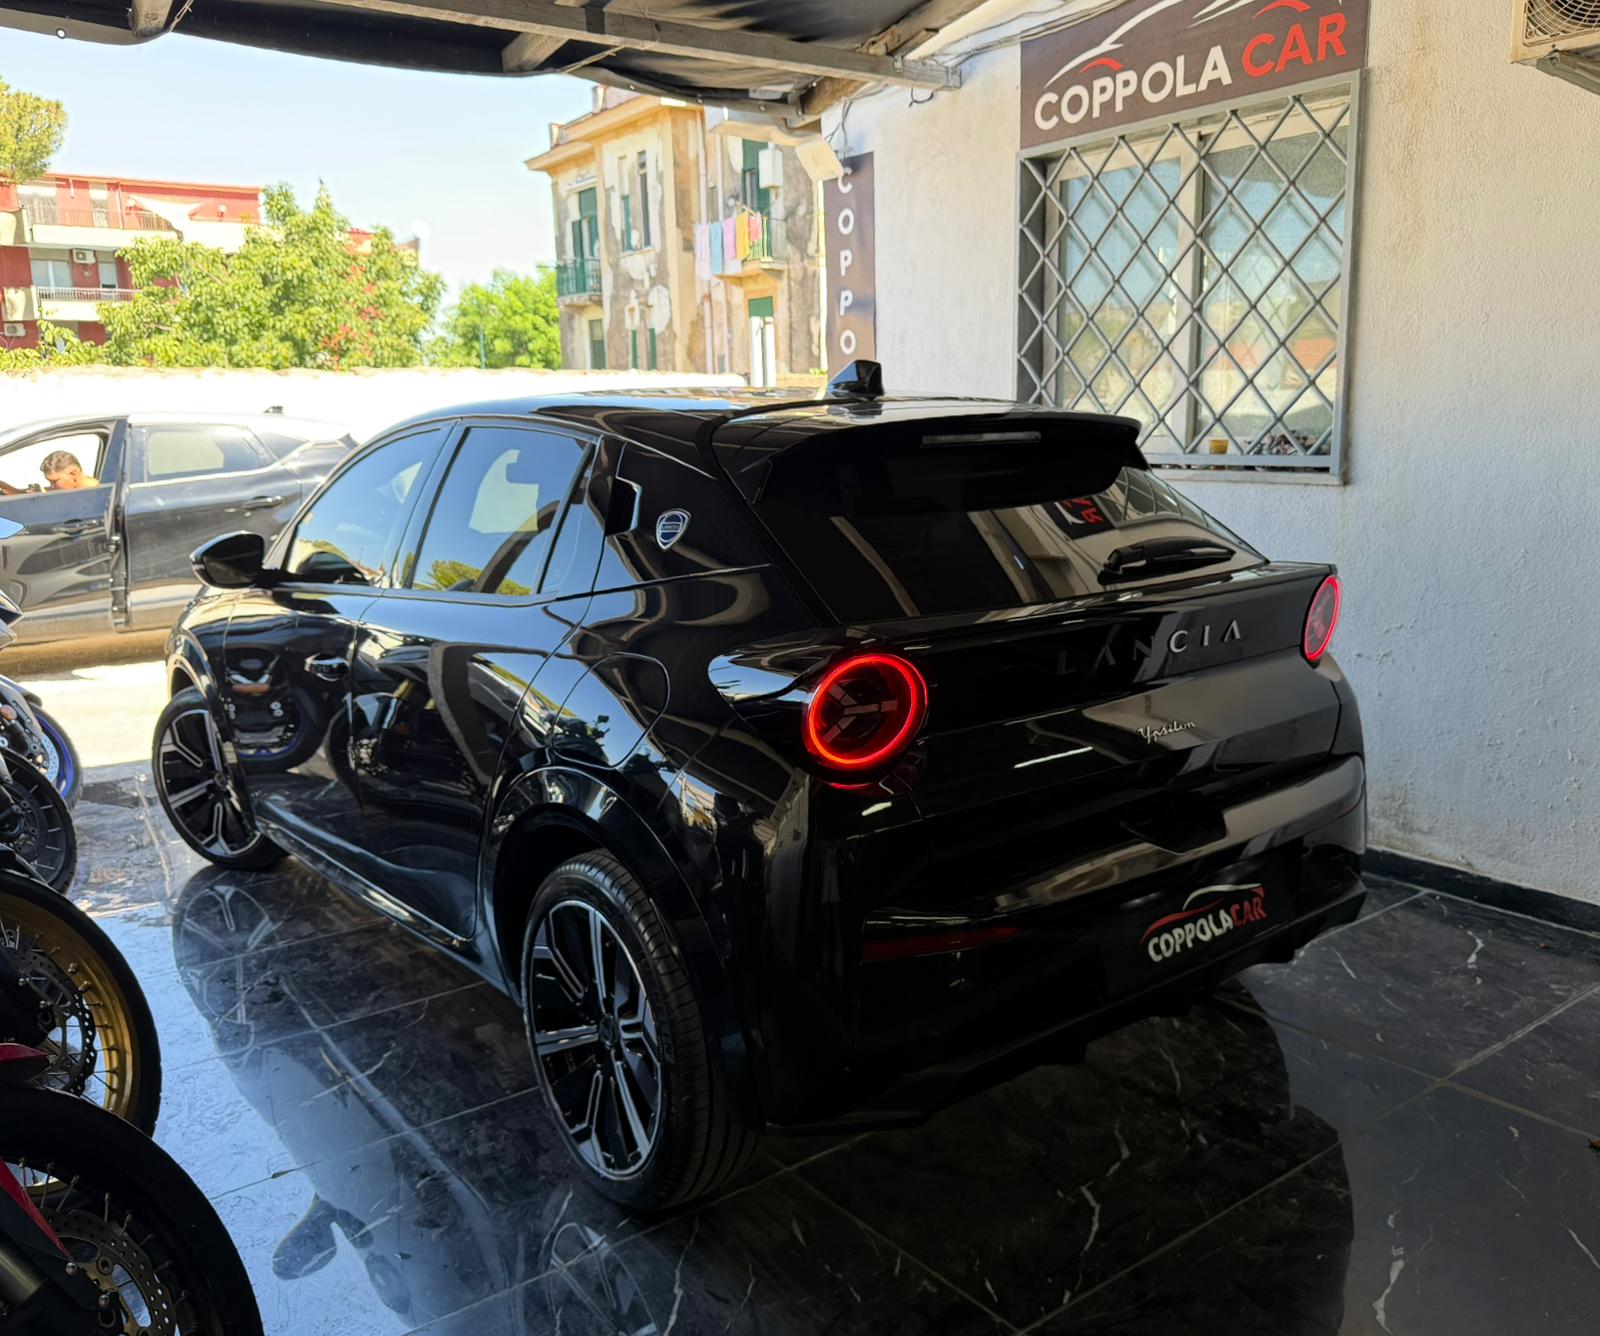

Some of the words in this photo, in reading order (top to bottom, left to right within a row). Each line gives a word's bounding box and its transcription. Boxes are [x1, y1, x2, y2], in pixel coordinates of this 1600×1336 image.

[1034, 45, 1232, 130] COPPOLA
[1242, 12, 1347, 77] CAR
[1137, 720, 1196, 744] Ypsilon
